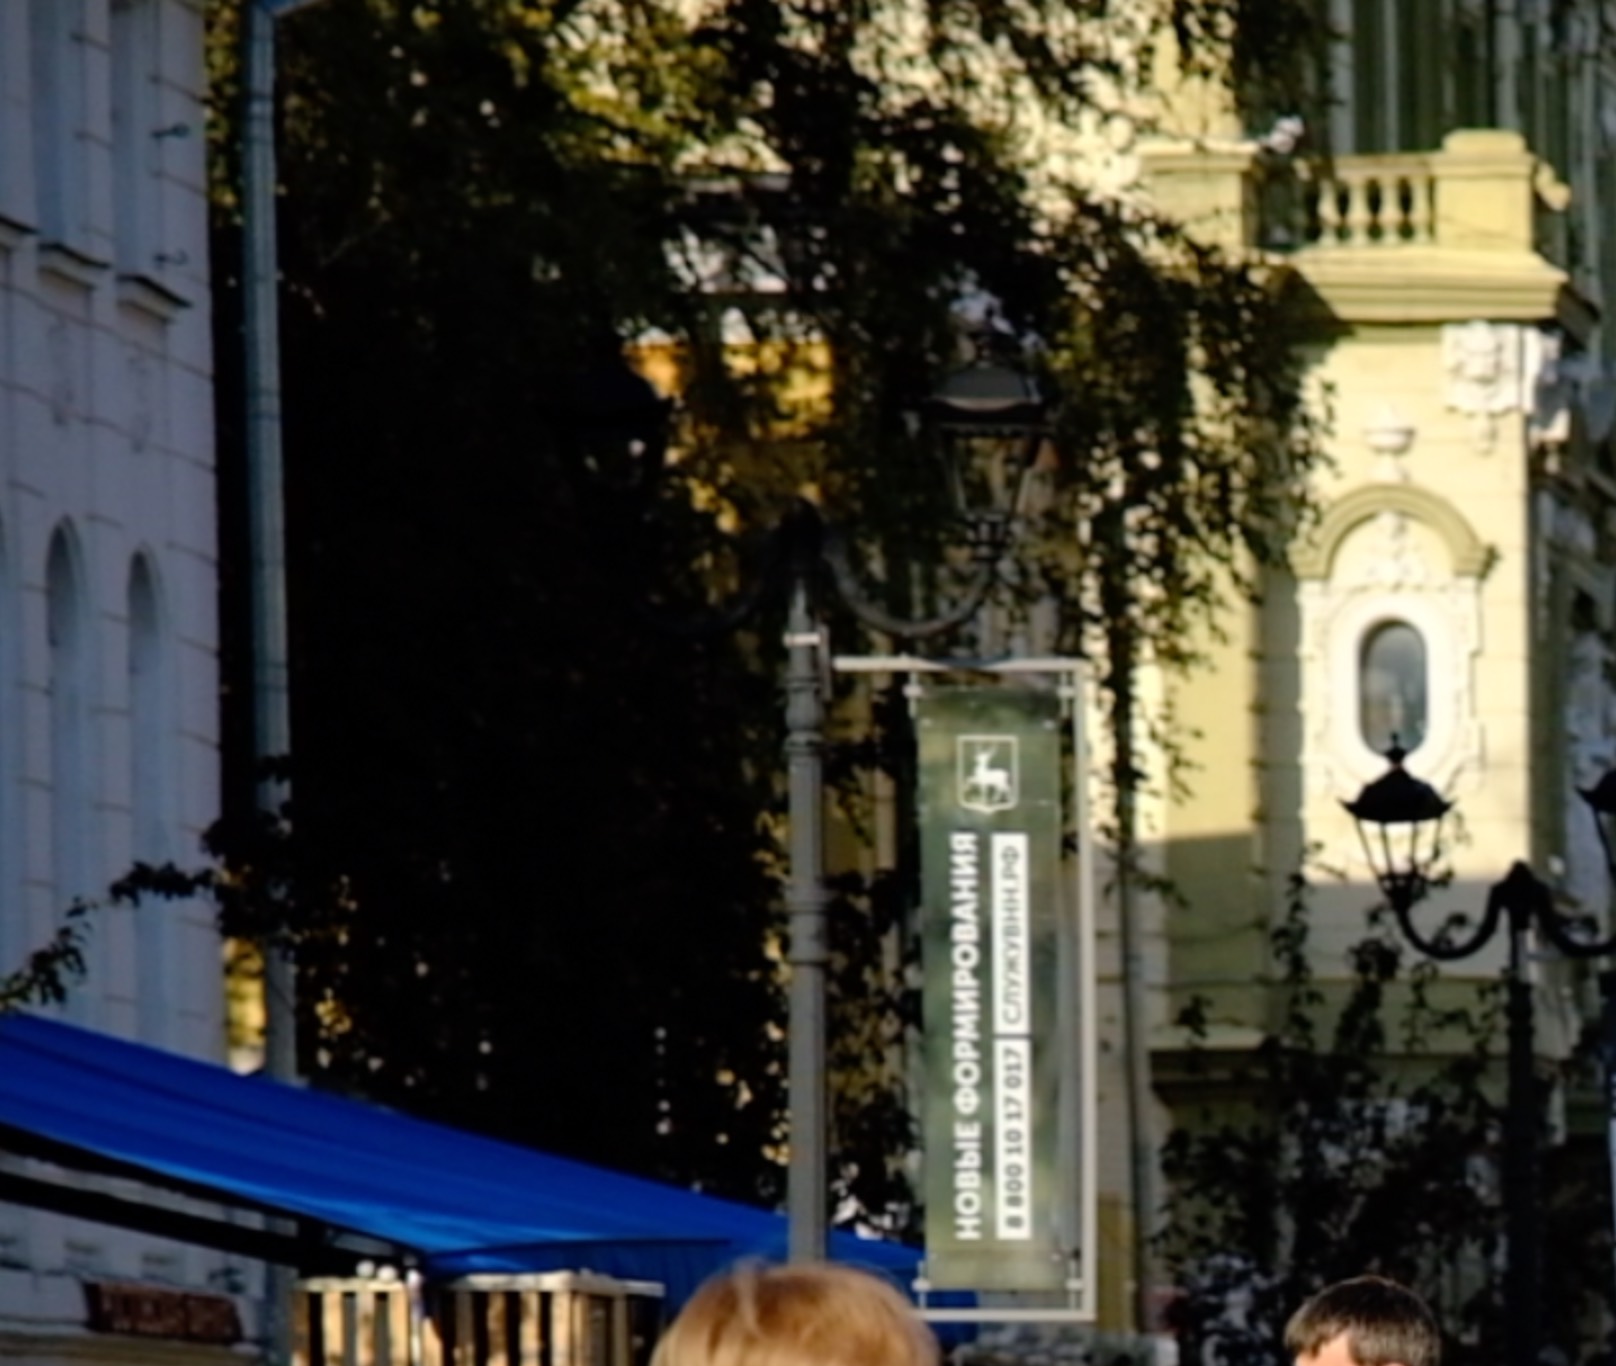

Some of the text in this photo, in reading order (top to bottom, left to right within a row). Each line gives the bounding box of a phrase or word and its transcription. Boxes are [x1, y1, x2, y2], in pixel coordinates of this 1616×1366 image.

[1000, 845, 1022, 1026] СЛУЖУВНН.РФ
[950, 832, 983, 1241] НОВЫЕ ФОРМИРОВАНИЯ
[1003, 1046, 1024, 1229] 8 800 10 17 017
